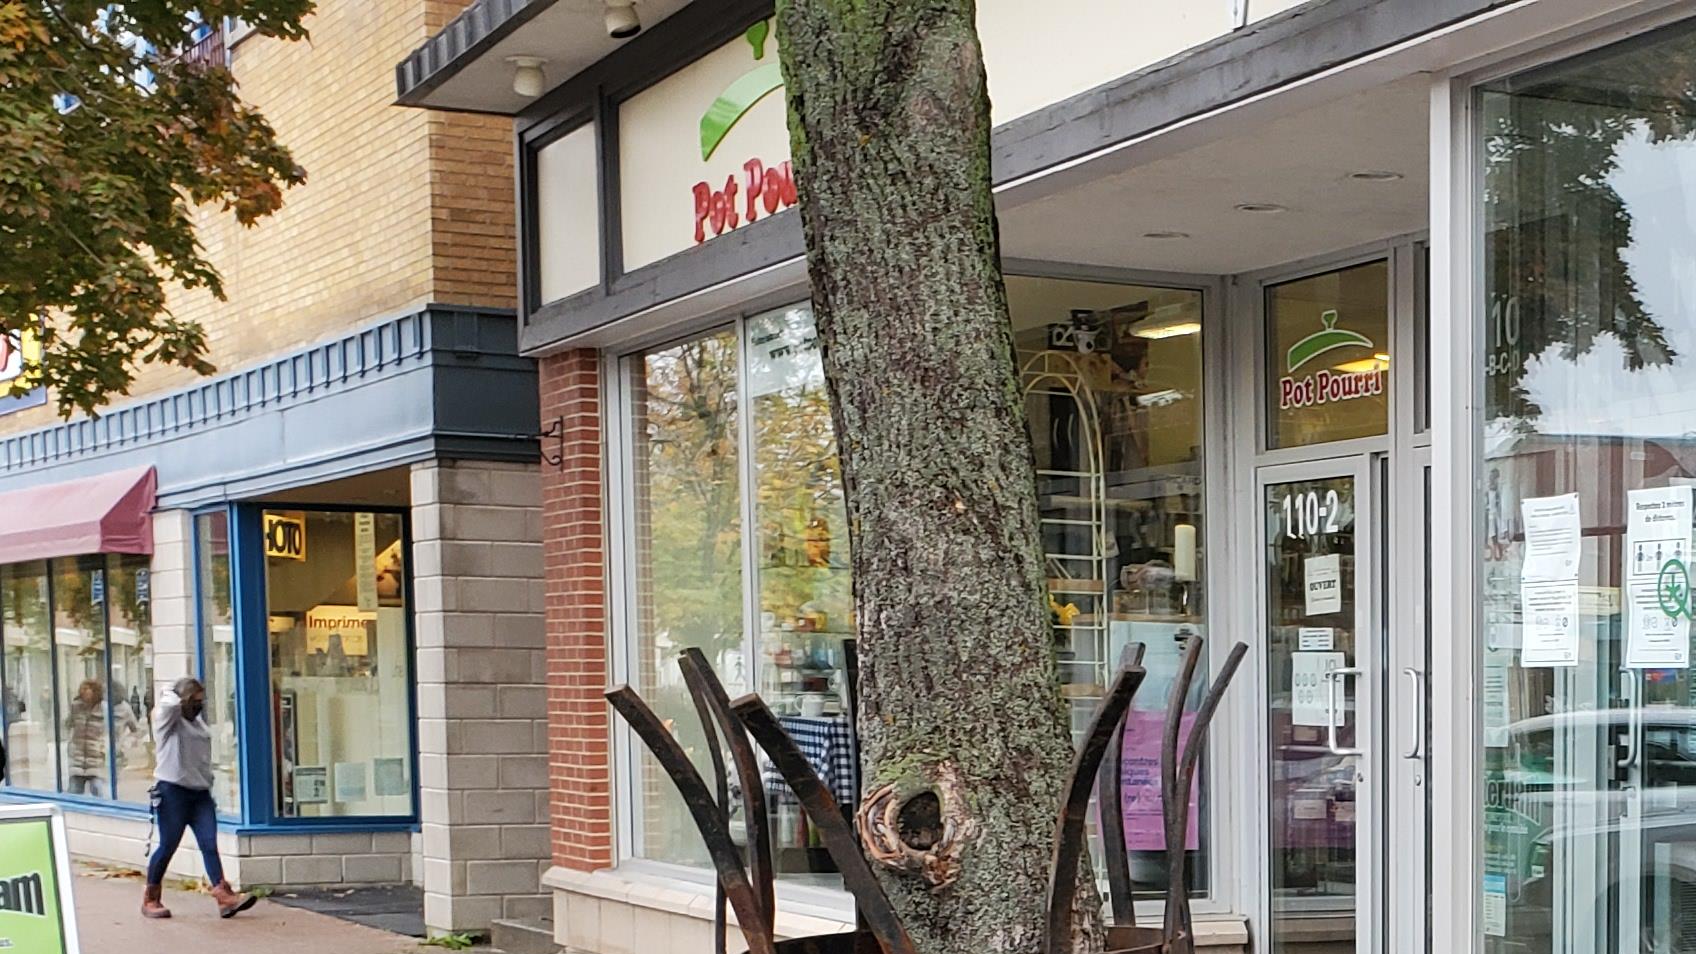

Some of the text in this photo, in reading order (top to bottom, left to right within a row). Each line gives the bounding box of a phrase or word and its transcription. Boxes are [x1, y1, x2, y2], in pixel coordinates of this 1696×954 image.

[692, 174, 738, 244] Pot
[1280, 363, 1383, 410] Pot Pourri
[1283, 489, 1339, 540] 110-2
